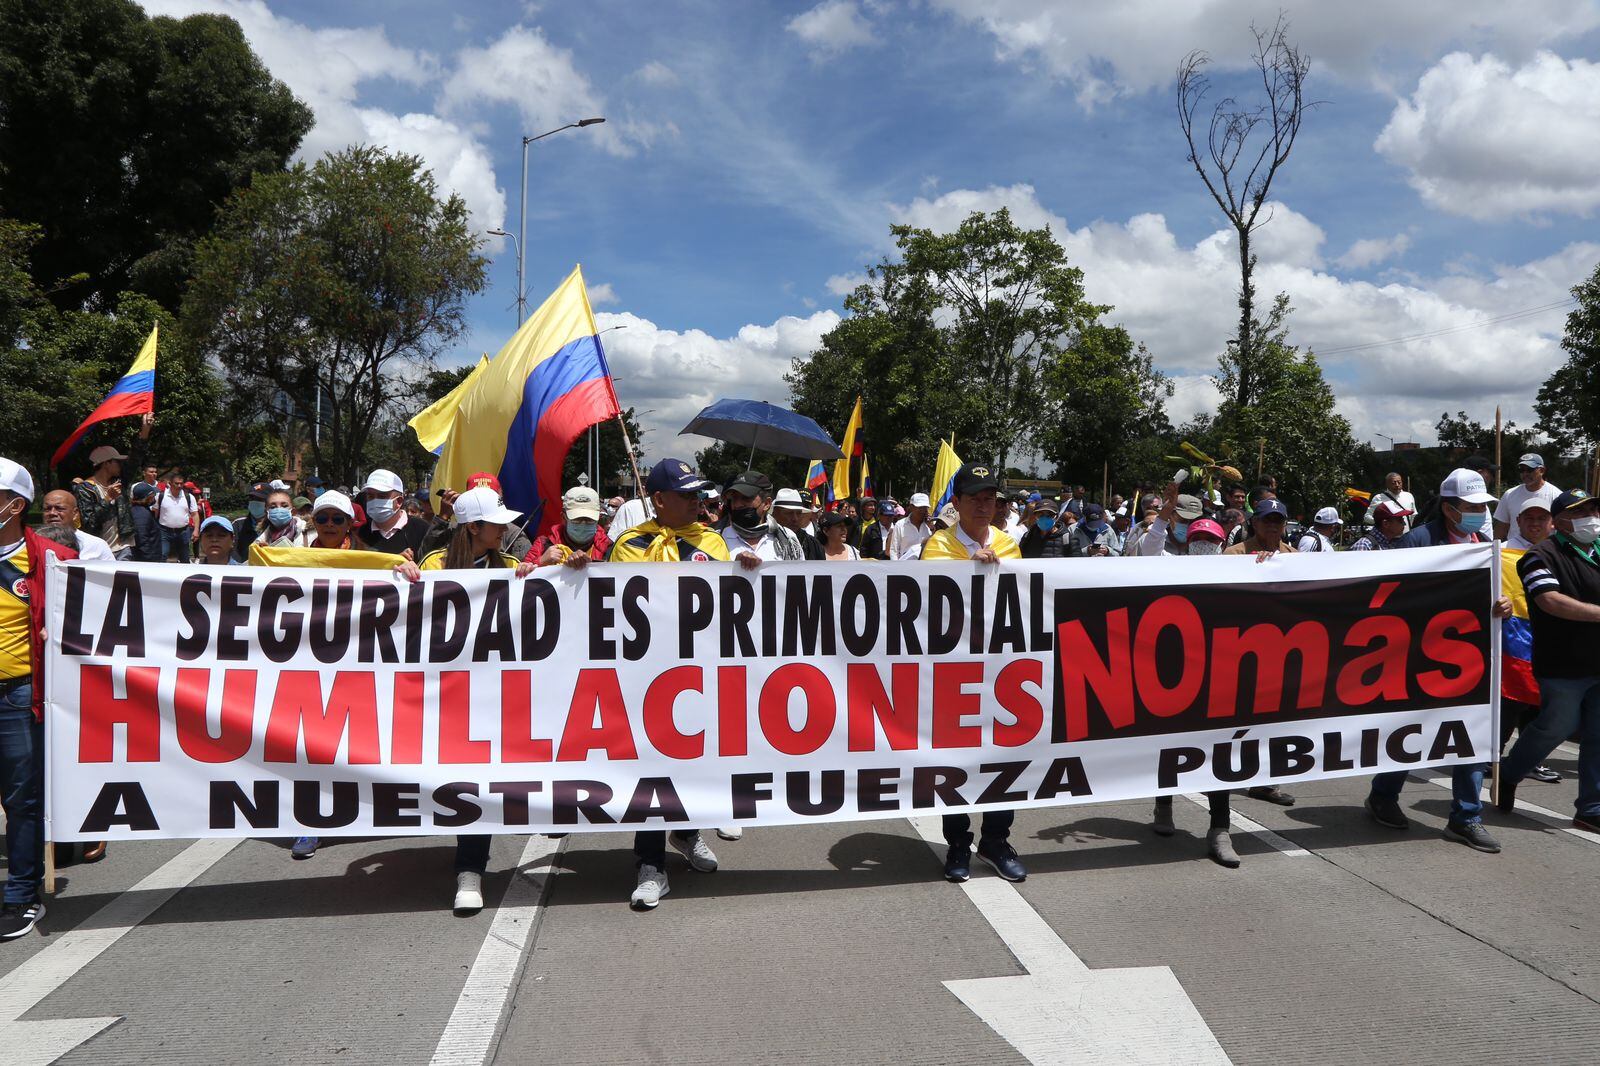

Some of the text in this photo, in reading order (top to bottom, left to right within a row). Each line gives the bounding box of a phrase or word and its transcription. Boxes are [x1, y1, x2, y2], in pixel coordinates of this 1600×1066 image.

[61, 566, 1054, 664] LA SEGURIDAD ES PRIMORDIAL
[1057, 581, 1486, 743] NOmás
[79, 658, 1044, 765] HUMILLACIONES
[79, 720, 1476, 833] A NUESTRA FUERZA PÚBLICA
